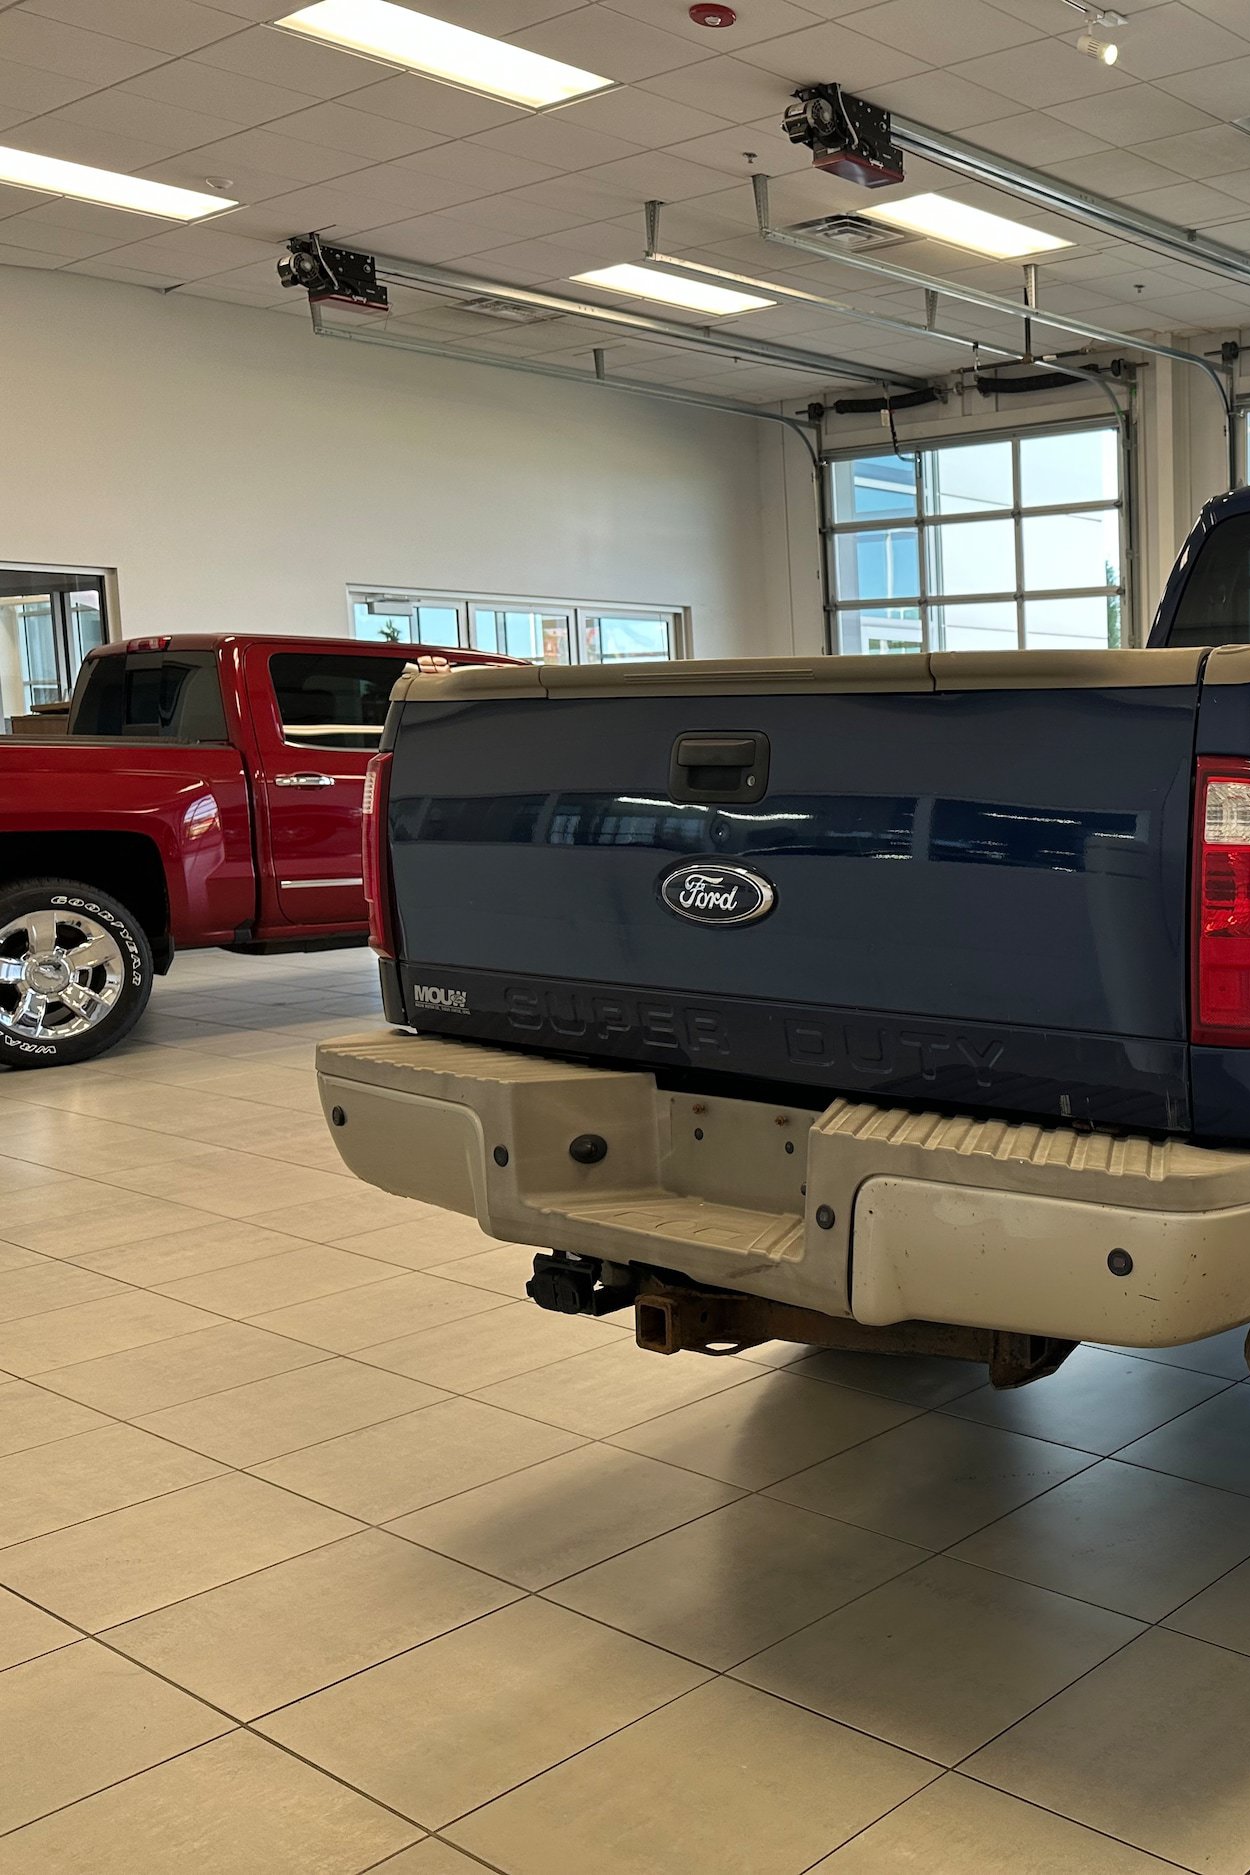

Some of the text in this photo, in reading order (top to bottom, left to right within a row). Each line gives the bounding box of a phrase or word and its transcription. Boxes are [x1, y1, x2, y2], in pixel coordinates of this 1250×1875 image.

[679, 873, 739, 911] Ford
[51, 895, 142, 987] GOODYEAR
[0, 1030, 57, 1054] WRA
[503, 986, 1004, 1088] SUPER DUTY
